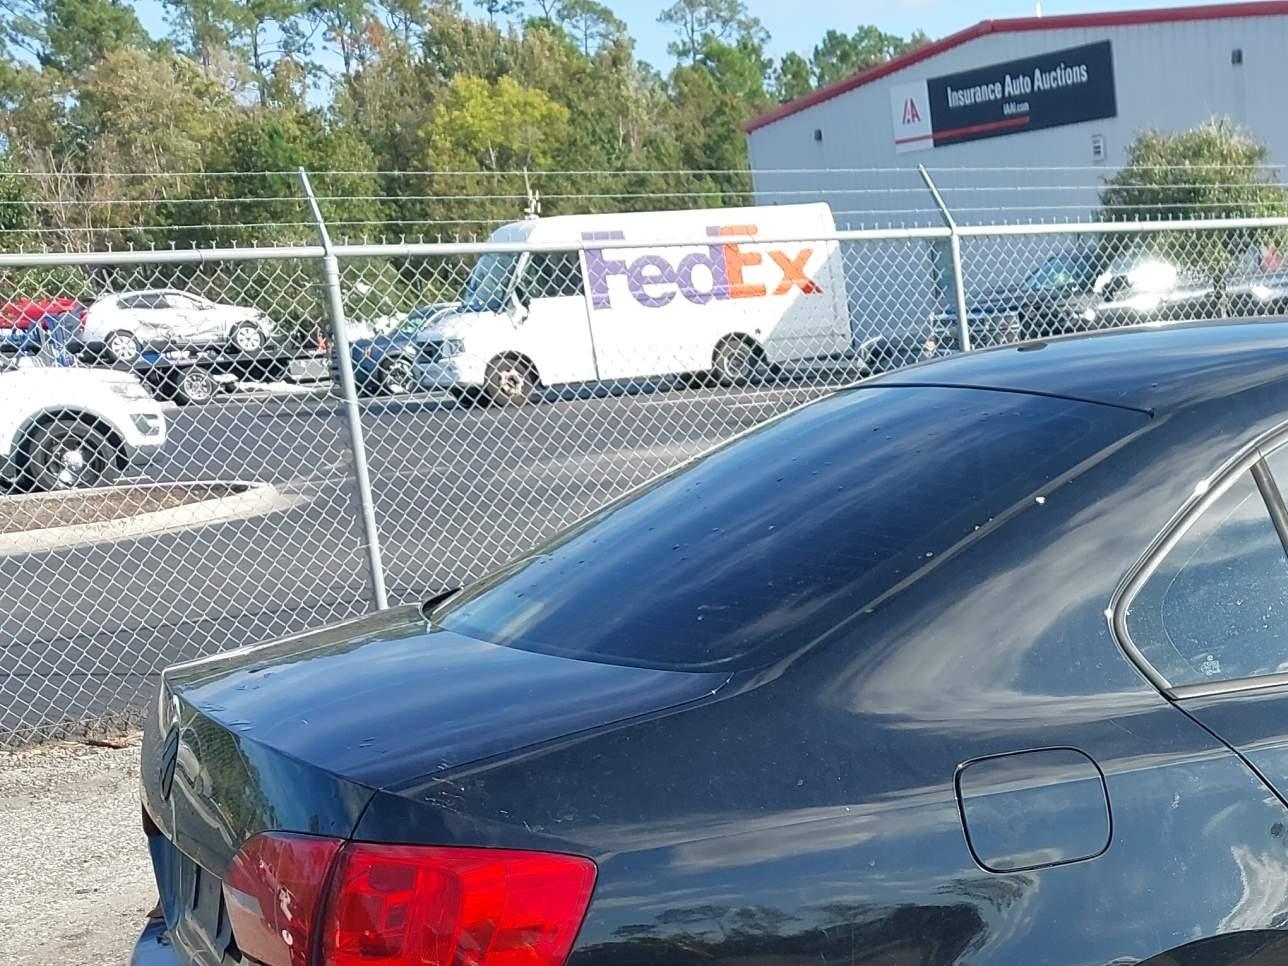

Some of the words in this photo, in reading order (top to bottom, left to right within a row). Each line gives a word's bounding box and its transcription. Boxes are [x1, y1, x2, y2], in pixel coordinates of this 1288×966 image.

[947, 82, 1003, 108] Insurance
[1004, 74, 1032, 98] Auto
[1033, 63, 1089, 93] Auctions
[581, 224, 823, 310] FedEx
